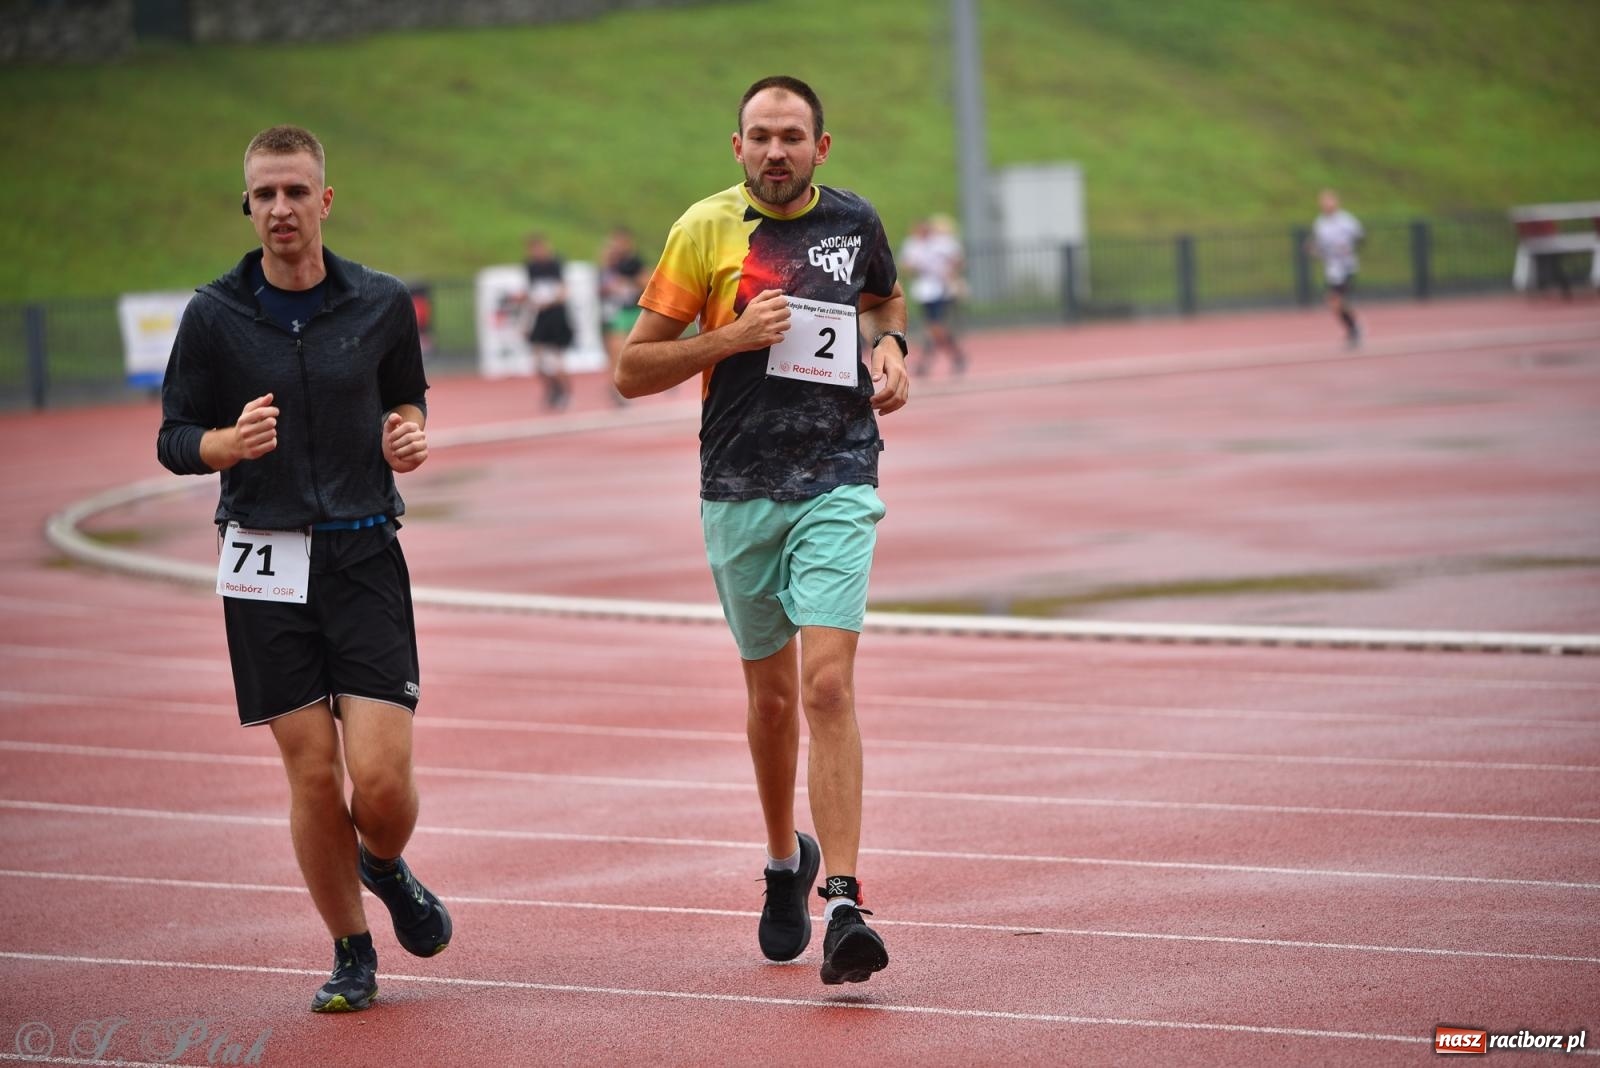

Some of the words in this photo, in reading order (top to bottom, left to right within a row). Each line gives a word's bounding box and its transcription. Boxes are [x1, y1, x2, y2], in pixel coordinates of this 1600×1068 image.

[820, 235, 861, 249] KOCHAM
[808, 246, 861, 285] GÓRY
[814, 327, 836, 360] 2
[792, 364, 832, 378] Racibórz
[232, 541, 275, 577] 71
[225, 582, 263, 594] Racibórz
[272, 586, 295, 597] OSiR
